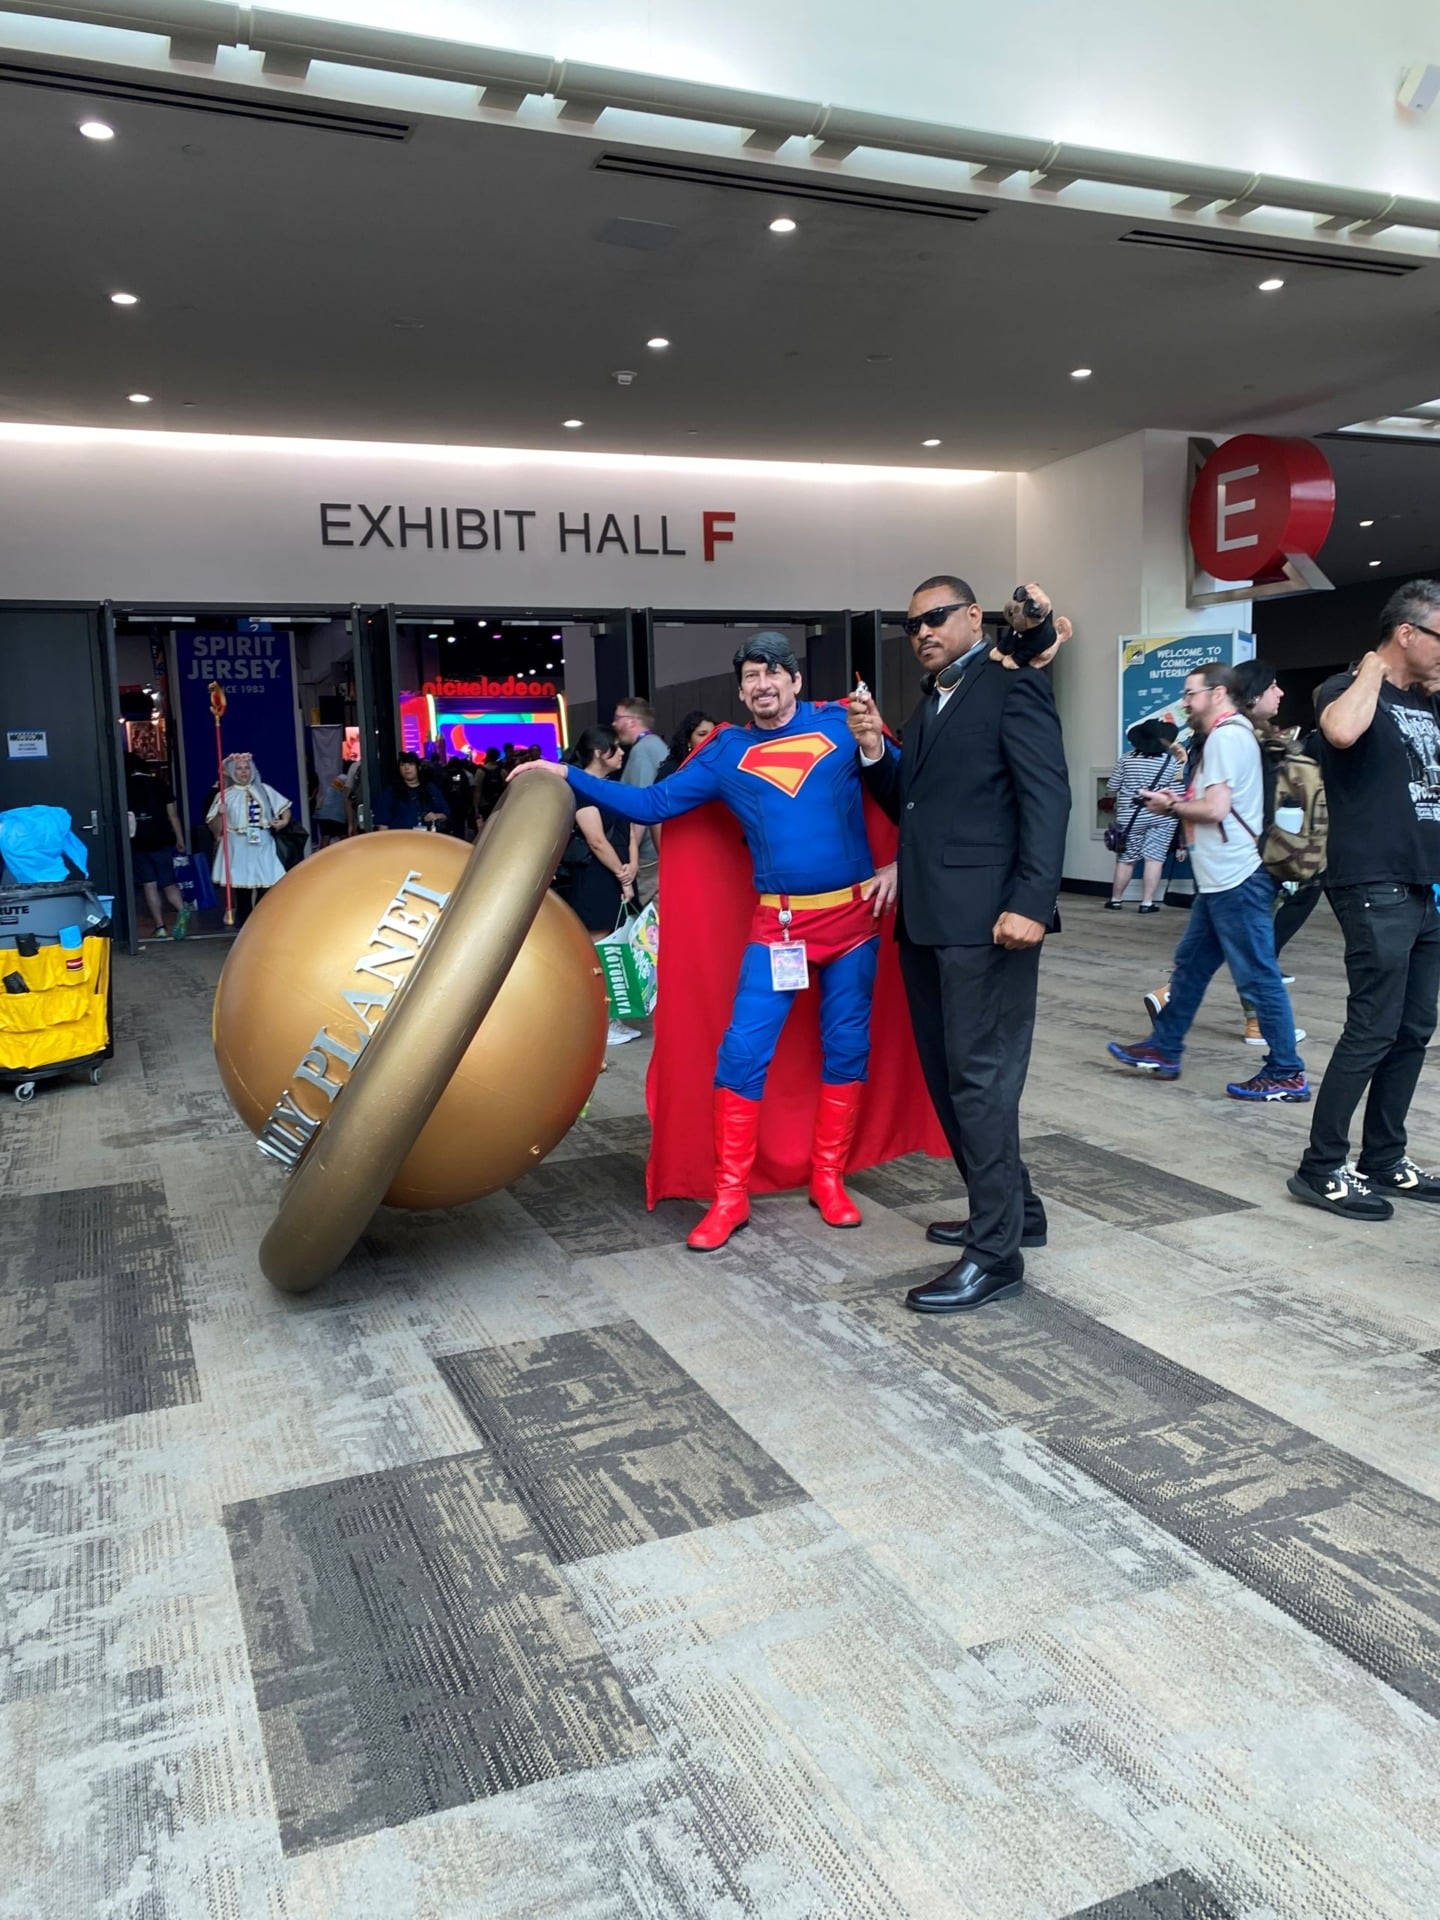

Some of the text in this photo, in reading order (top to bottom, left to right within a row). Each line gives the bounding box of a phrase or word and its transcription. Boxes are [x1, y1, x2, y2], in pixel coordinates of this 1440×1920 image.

[1216, 464, 1260, 553] E
[320, 503, 736, 562] EXHIBIT HALL F
[193, 635, 276, 657] SPIRIT
[1157, 646, 1222, 659] WELCOME TO
[187, 659, 281, 680] JERSEY
[241, 685, 265, 694] 1983
[422, 675, 556, 697] nickelodeon
[293, 869, 451, 1103] PLANET
[603, 945, 632, 1016] KOTOBUKIYA
